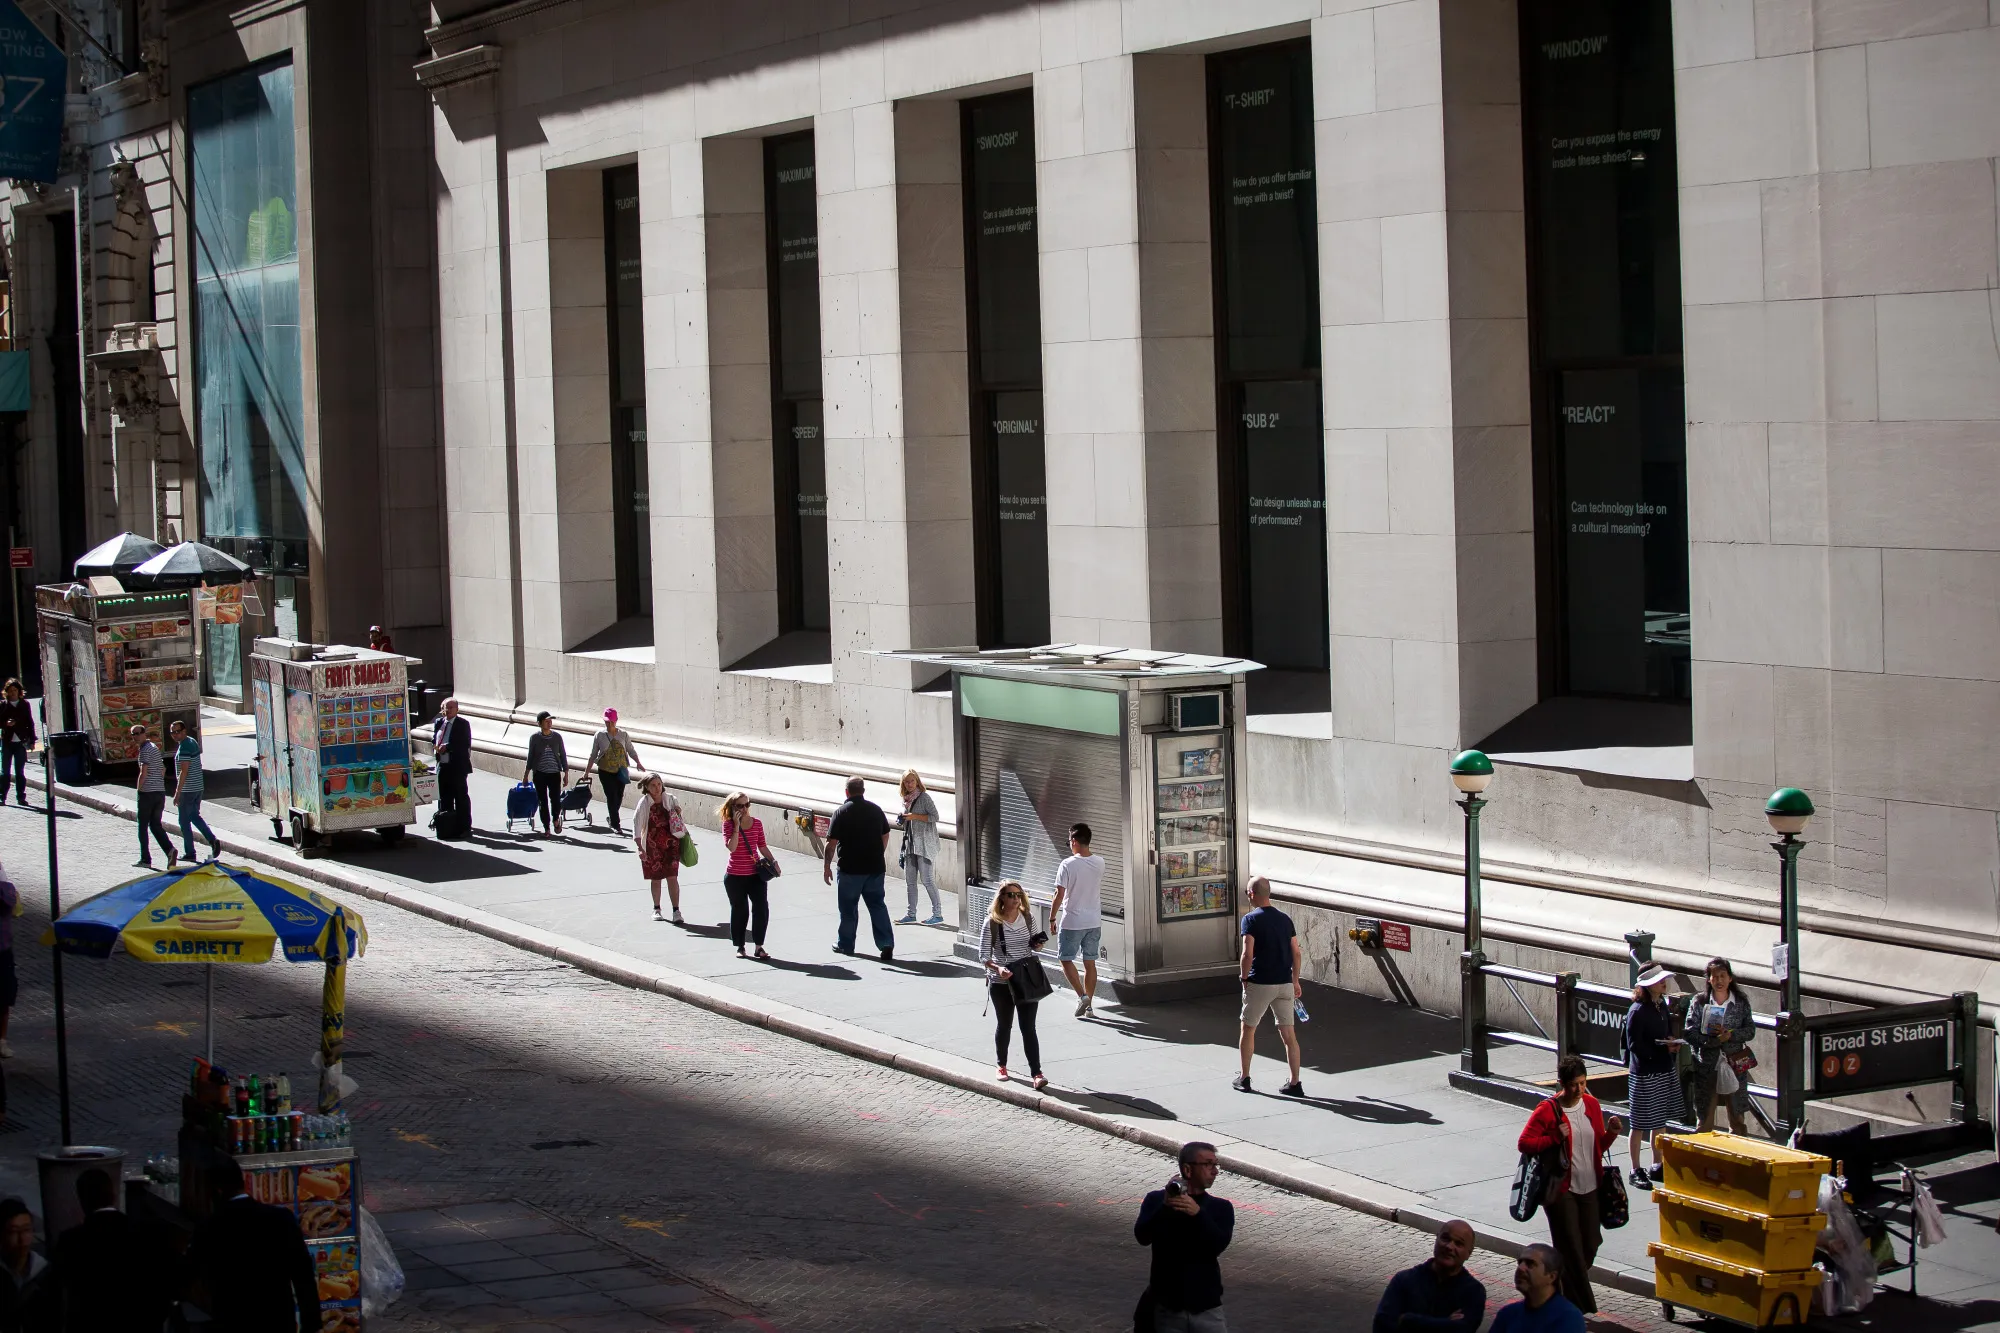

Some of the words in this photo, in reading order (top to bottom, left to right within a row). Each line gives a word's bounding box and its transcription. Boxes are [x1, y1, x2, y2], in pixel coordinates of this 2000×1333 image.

[1541, 35, 1608, 60] "WINDOW"
[1225, 87, 1275, 109] "T-SHIRT"
[977, 131, 1018, 150] "SWOOSH"
[1552, 137, 1568, 149] Can
[1569, 137, 1584, 150] you
[1587, 133, 1616, 147] expose
[1617, 129, 1631, 141] the
[1632, 127, 1661, 140] energy
[1578, 154, 1600, 166] these
[1602, 149, 1632, 163] shoes?
[1233, 177, 1247, 188] How
[1248, 175, 1257, 186] do
[1258, 175, 1270, 187] you
[1271, 172, 1286, 183] offer
[1287, 169, 1312, 181] familiar
[1233, 195, 1253, 207] things
[1254, 192, 1268, 203] with
[1274, 188, 1294, 201] twist?
[983, 210, 993, 220] Can
[1242, 413, 1267, 429] "SUB
[1269, 412, 1280, 428] 2"
[1562, 405, 1615, 424] "REACT"
[792, 426, 819, 439] "SPEED"
[993, 420, 1037, 434] "ORIGINAL"
[999, 495, 1012, 504] How
[1012, 495, 1019, 504] do
[1020, 496, 1029, 506] you
[1249, 496, 1263, 507] Can
[1264, 496, 1285, 510] design
[1286, 497, 1312, 508] unleash
[1312, 499, 1321, 508] an
[1571, 501, 1587, 513] Can
[1589, 501, 1634, 516] technology
[1636, 502, 1655, 515] take
[1656, 505, 1667, 515] on
[1000, 510, 1014, 520] blank
[1015, 510, 1036, 520] canvas?
[1250, 514, 1257, 524] of
[1258, 514, 1303, 526] performance?
[1572, 523, 1577, 532] a
[1578, 521, 1609, 533] cultural
[1610, 522, 1651, 537] meaning?
[150, 901, 245, 923] SABRETT
[154, 939, 244, 955] SABRETT
[1821, 1031, 1865, 1052] Broad
[1871, 1029, 1887, 1045] St
[1892, 1024, 1944, 1043] Station
[1827, 1060, 1835, 1073] J
[1847, 1058, 1856, 1071] Z
